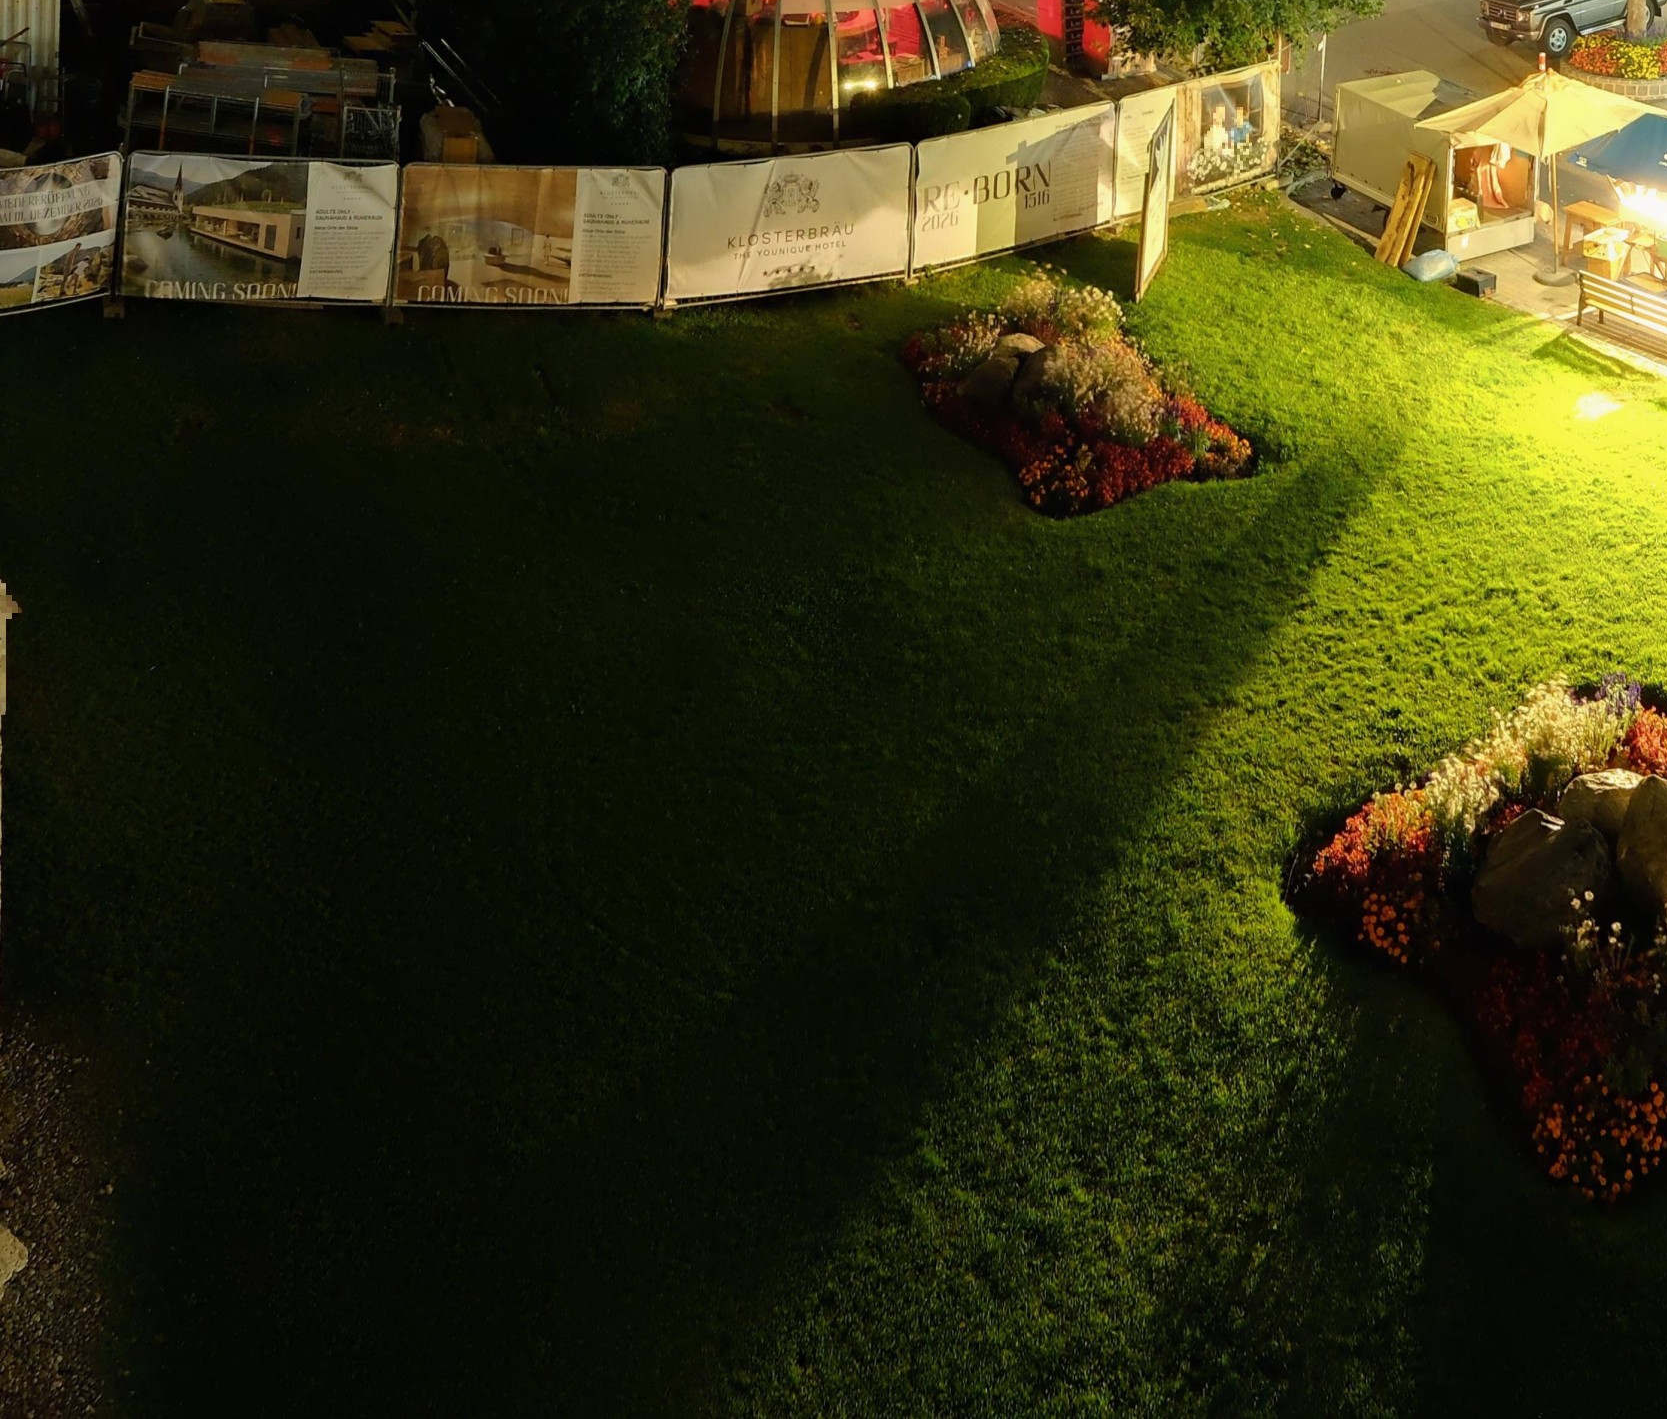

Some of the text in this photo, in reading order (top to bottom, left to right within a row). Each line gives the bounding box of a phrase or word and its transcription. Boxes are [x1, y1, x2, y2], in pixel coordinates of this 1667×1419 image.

[1024, 190, 1050, 210] 1516
[727, 221, 855, 250] KLOSTERBRÄU
[733, 240, 847, 261] THE YOUNIQUE HOTEL
